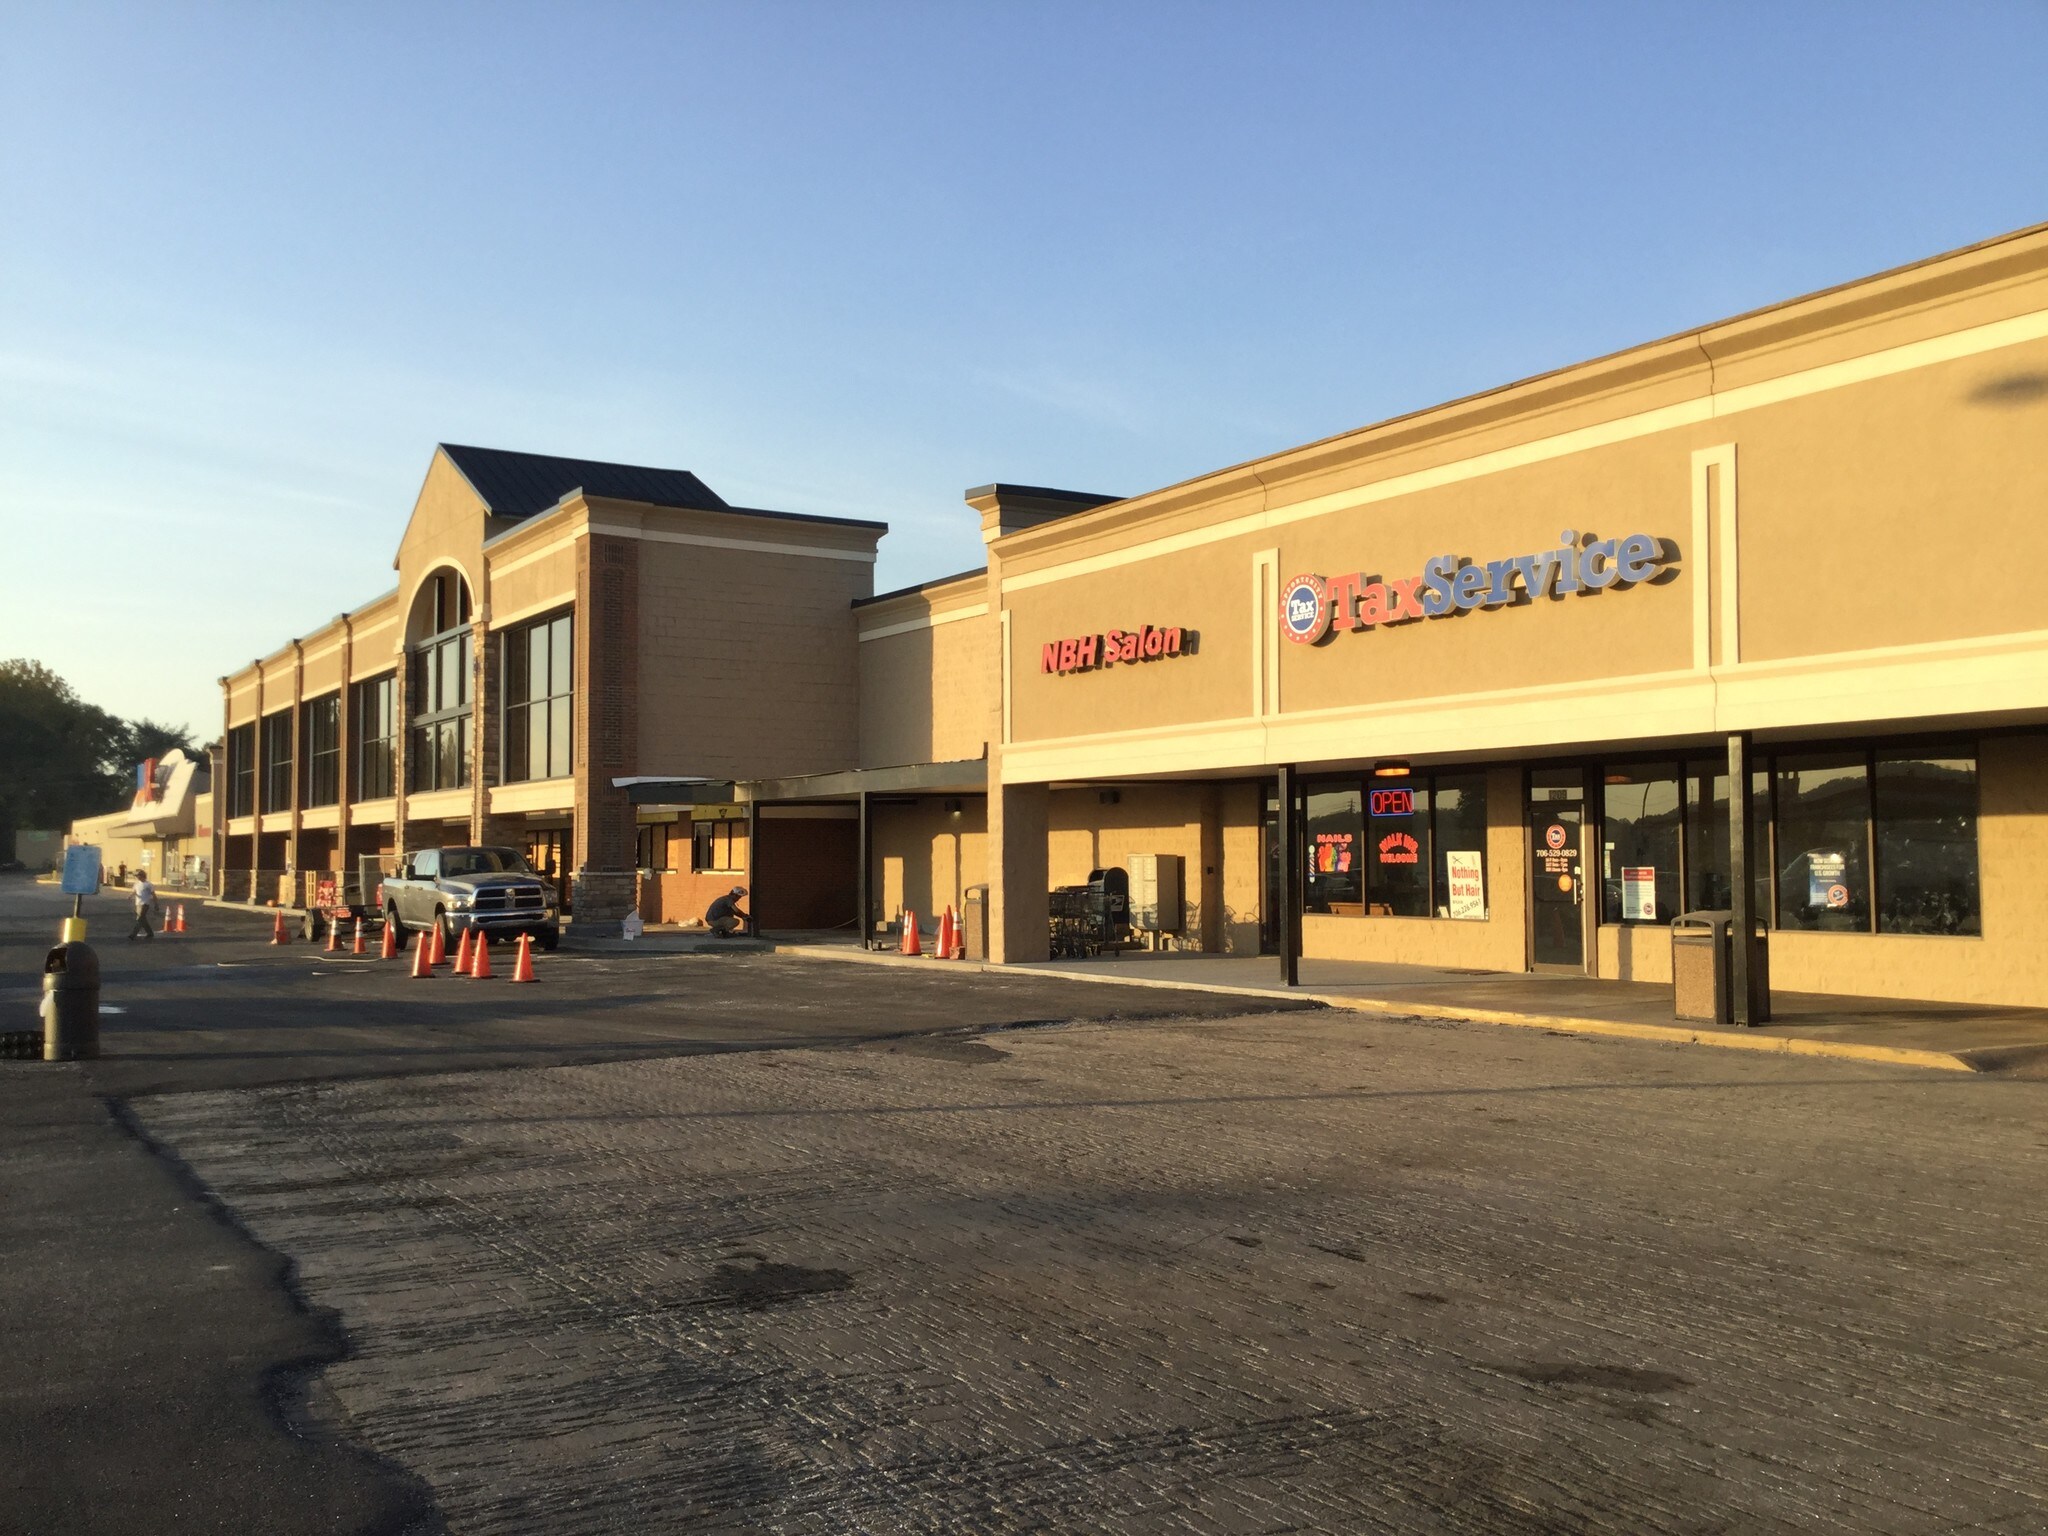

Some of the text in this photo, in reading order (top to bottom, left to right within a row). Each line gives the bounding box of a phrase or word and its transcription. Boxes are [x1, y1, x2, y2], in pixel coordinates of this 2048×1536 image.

[1281, 576, 1323, 607] OPPORTUNITY
[1291, 598, 1314, 615] Tax
[1291, 612, 1315, 622] SERVICE
[1041, 624, 1182, 674] NBH Salon
[1372, 791, 1414, 814] OPEN
[1316, 833, 1353, 843] NAILS
[1380, 853, 1418, 864] WELCOME
[1452, 866, 1479, 882] Nothing
[1452, 884, 1480, 896] But Hair
